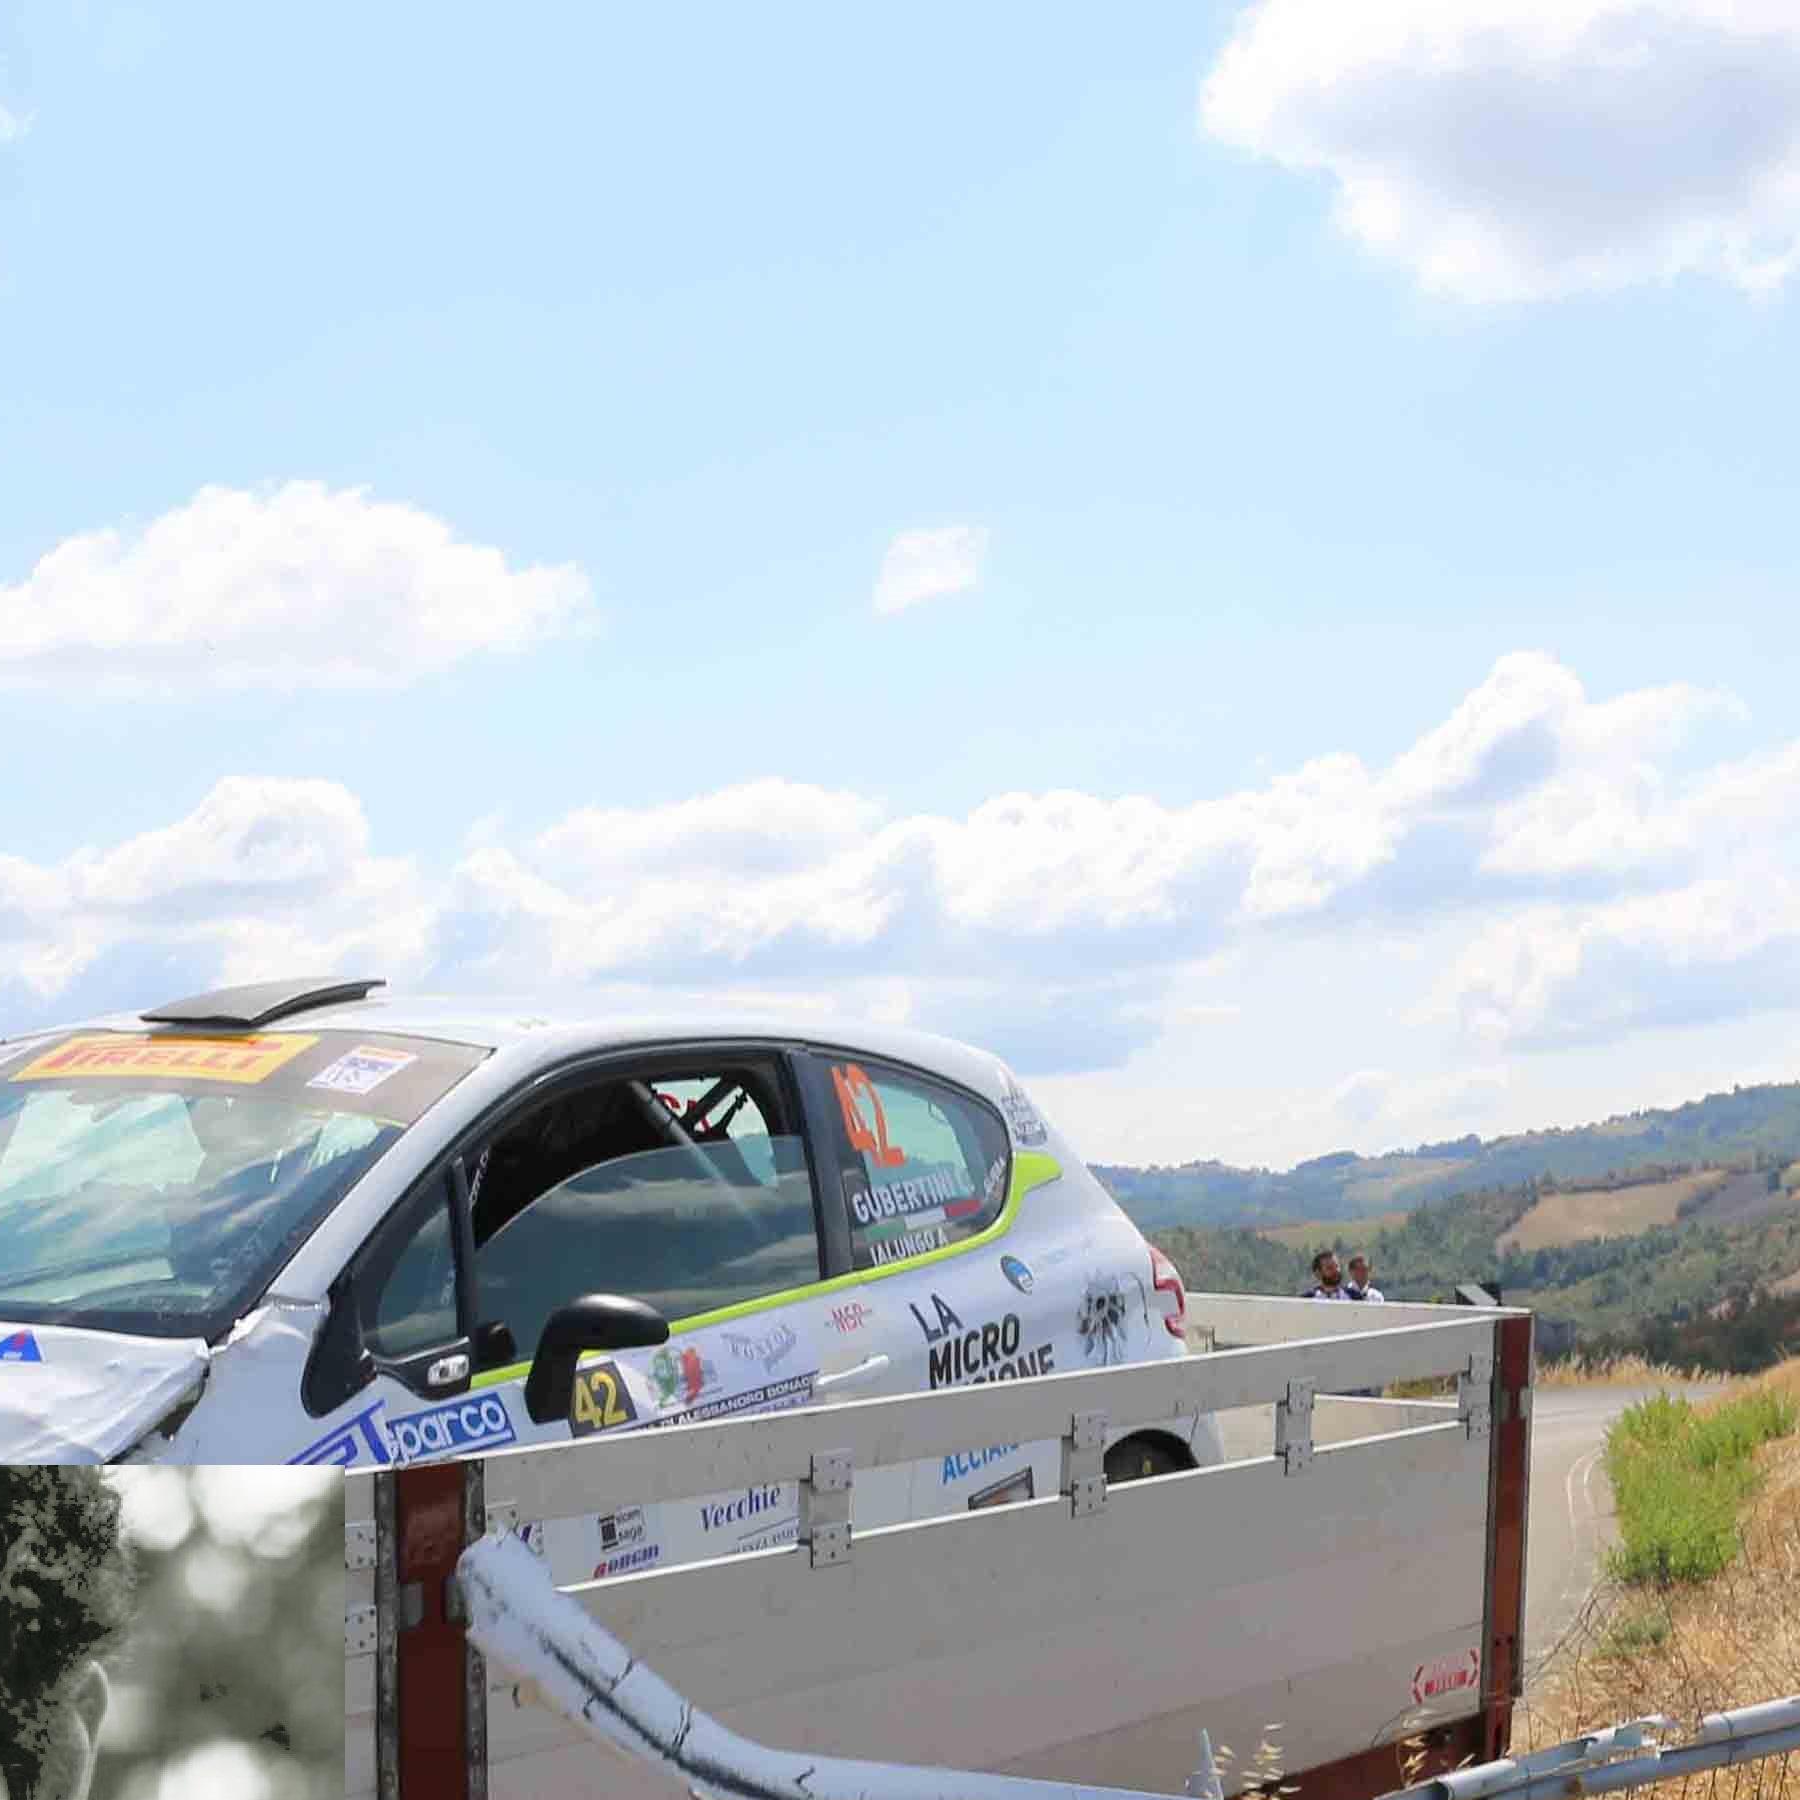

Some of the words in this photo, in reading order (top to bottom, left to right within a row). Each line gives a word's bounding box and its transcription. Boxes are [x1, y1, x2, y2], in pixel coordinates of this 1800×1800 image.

[47, 1037, 283, 1072] PIRELLI
[831, 1063, 907, 1168] 42
[909, 1292, 963, 1343] LA
[929, 1312, 1021, 1390] MICRO
[573, 1370, 628, 1429] 42
